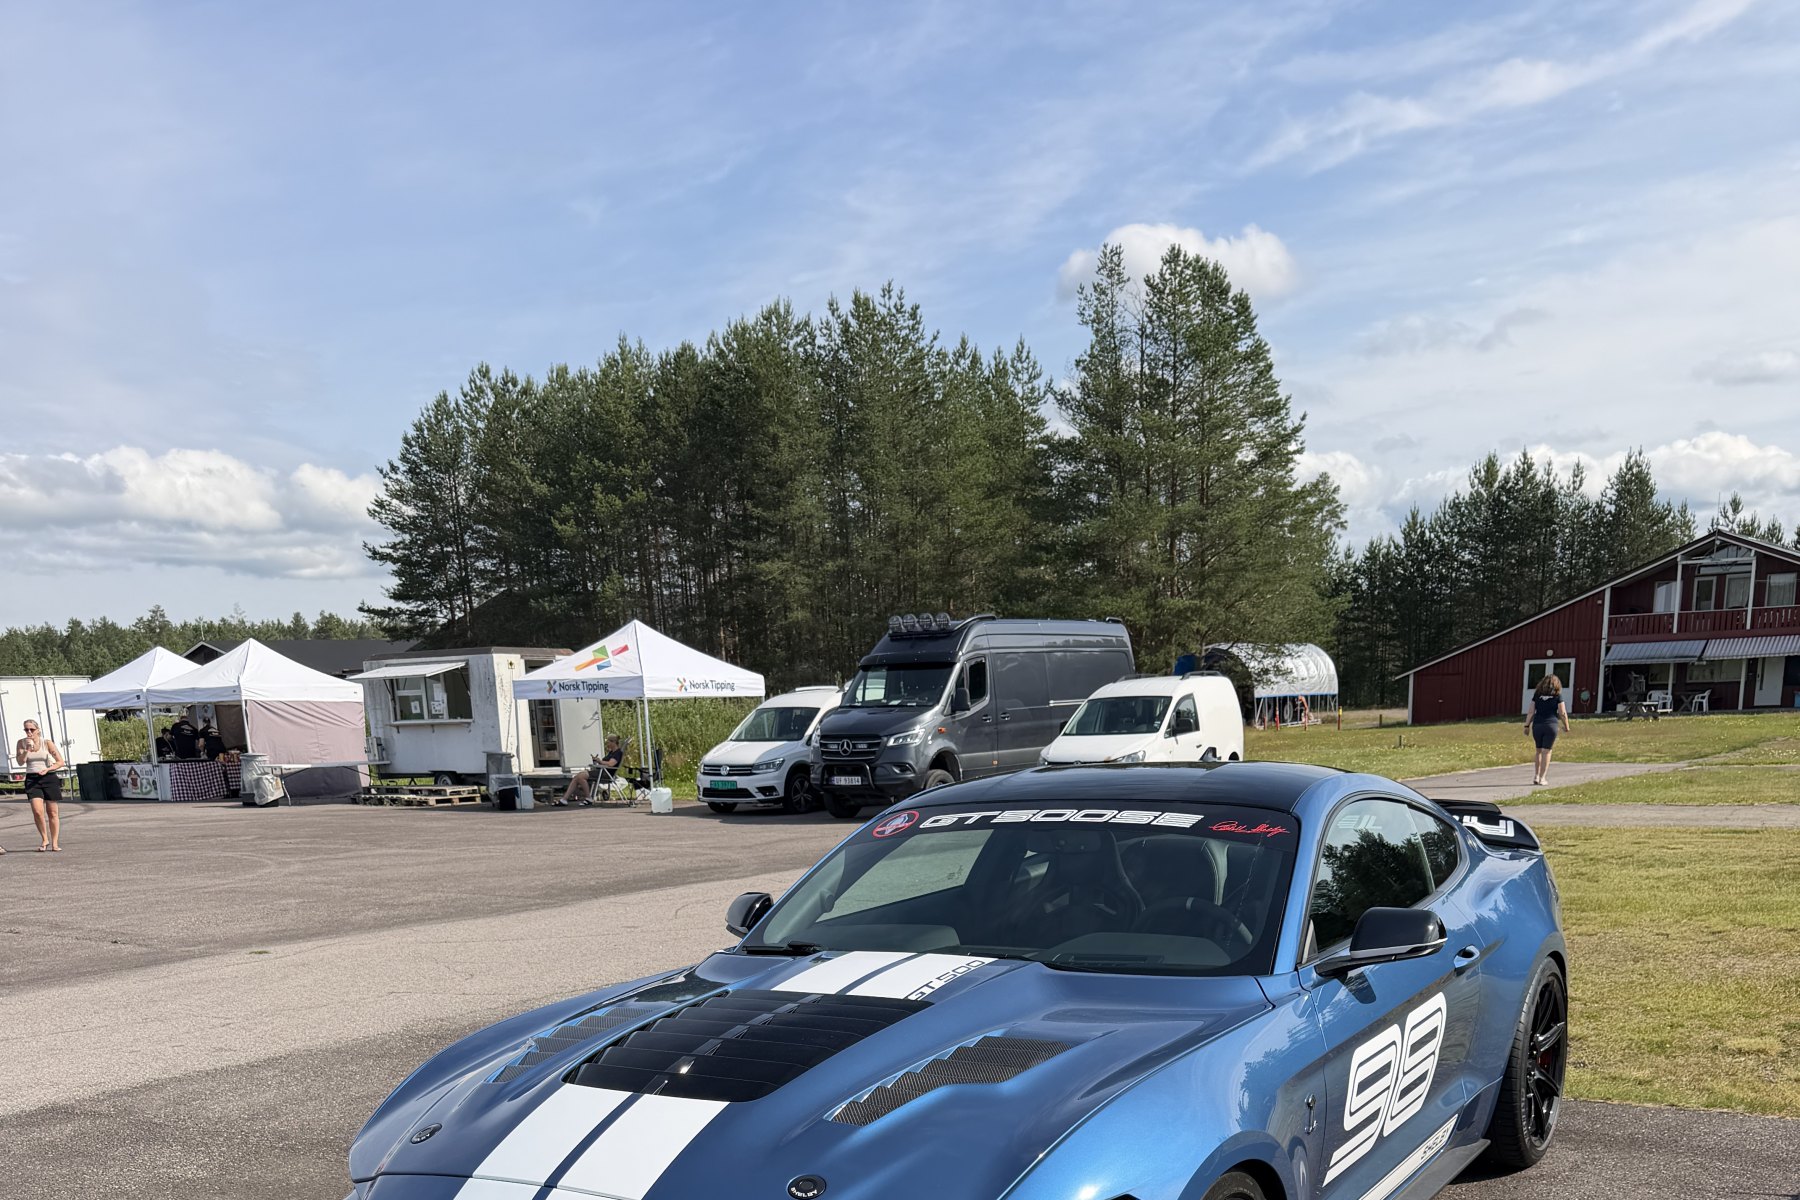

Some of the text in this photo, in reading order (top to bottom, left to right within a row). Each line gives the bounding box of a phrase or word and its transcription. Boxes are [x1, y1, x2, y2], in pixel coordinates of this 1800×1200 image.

[558, 681, 609, 693] Norsk Tipping
[689, 680, 735, 692] Norsk Tipping
[919, 809, 1204, 829] GT500SE
[903, 959, 985, 1001] GT 500
[1322, 991, 1447, 1188] 98
[790, 1186, 817, 1198] SHELBY
